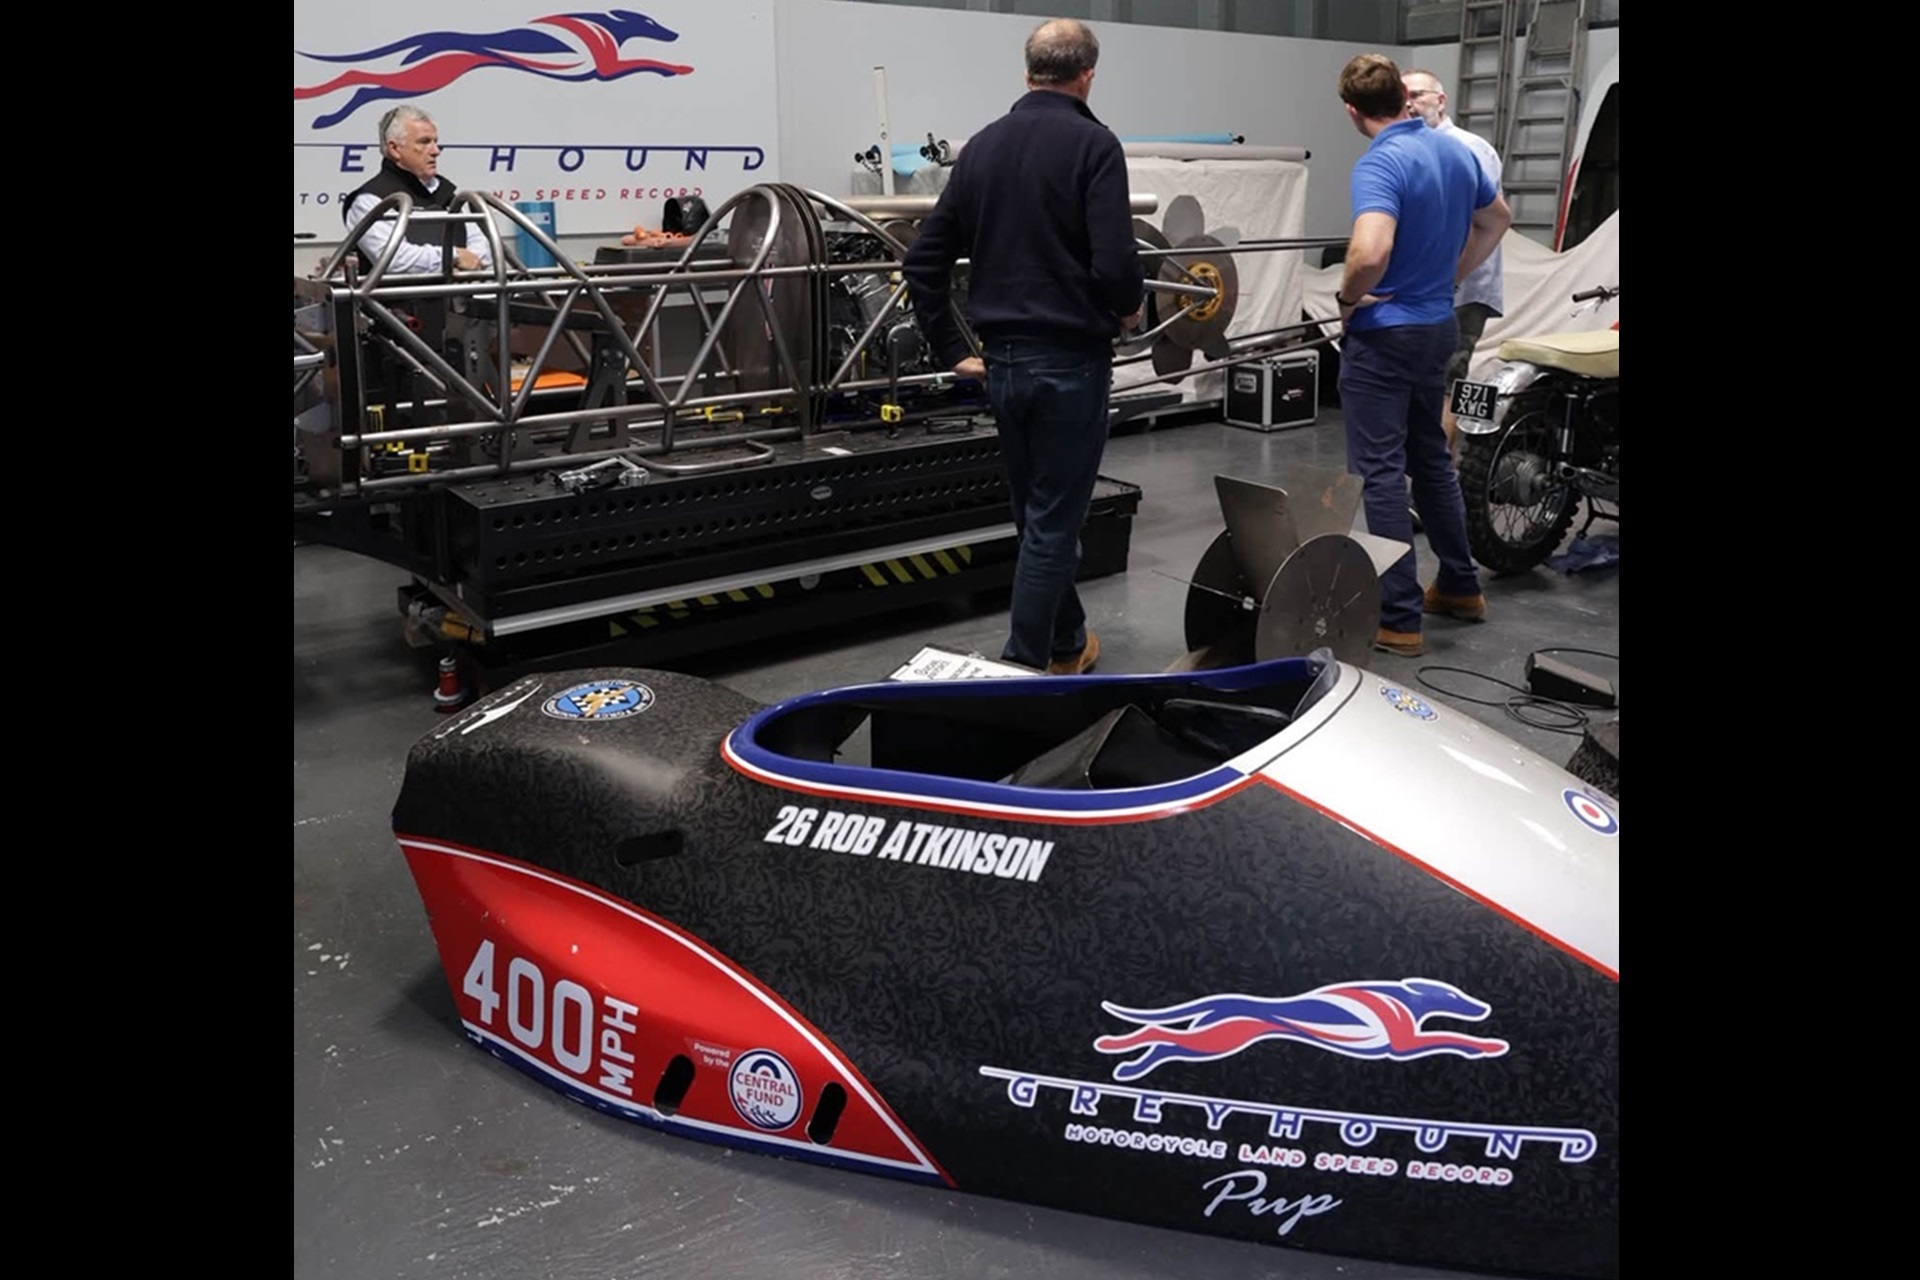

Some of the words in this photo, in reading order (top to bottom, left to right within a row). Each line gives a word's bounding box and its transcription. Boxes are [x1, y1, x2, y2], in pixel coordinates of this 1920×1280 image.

[535, 189, 606, 201] SPEED
[620, 187, 703, 200] RECORD
[1461, 384, 1489, 401] 971
[1457, 398, 1488, 417] XWG
[763, 805, 819, 846] 26
[809, 811, 886, 856] ROB
[877, 820, 1054, 883] ATKINSON
[463, 939, 594, 1075] 400
[599, 995, 640, 1097] MPH
[693, 1042, 731, 1058] Powered
[703, 1055, 714, 1066] by
[715, 1057, 730, 1068] the
[735, 1071, 796, 1098] CENTRAL
[746, 1088, 784, 1107] FUND
[1005, 1074, 1597, 1163] GREYHOUND
[1065, 1123, 1227, 1159] MOTORCYCLE
[1238, 1143, 1307, 1167] LAND
[1313, 1152, 1399, 1176] SPEED
[1406, 1161, 1514, 1186] RECORD
[1202, 1169, 1344, 1236] Pup
